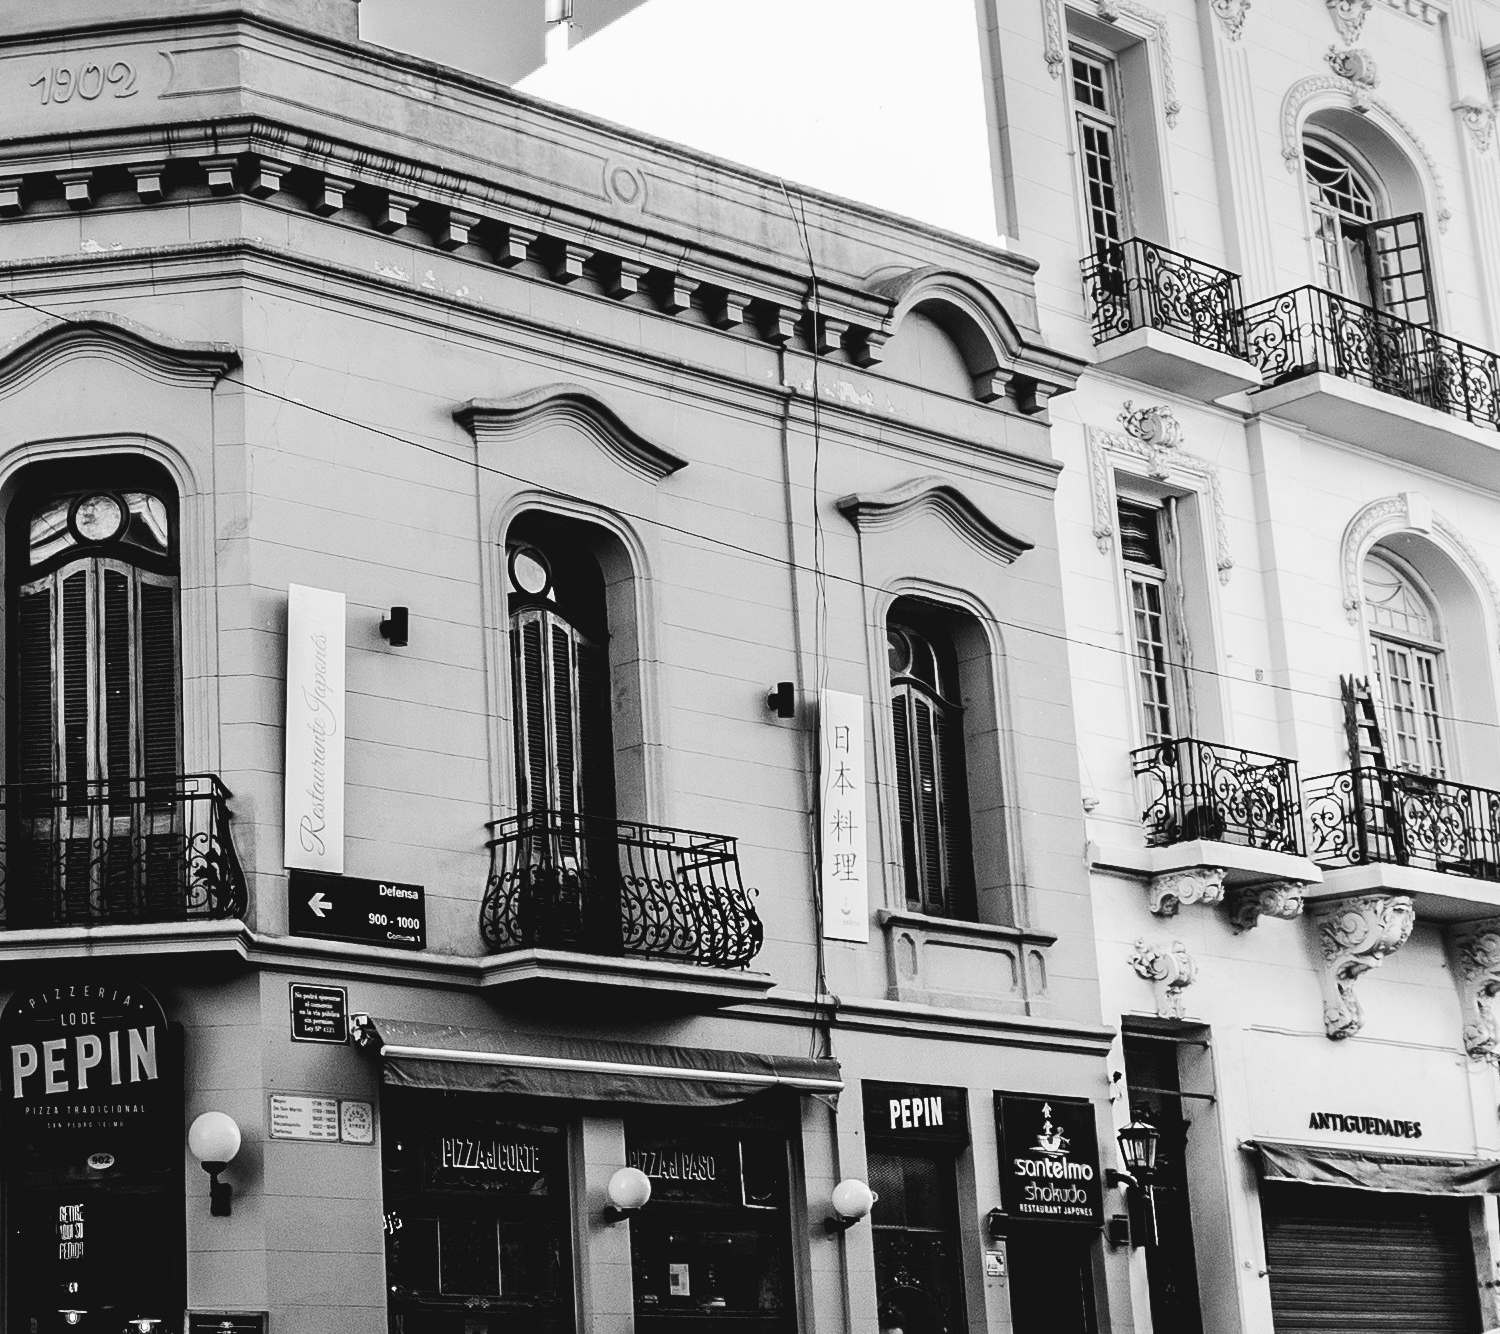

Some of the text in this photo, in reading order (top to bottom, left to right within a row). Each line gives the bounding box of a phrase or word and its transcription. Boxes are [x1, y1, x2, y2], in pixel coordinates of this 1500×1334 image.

[29, 62, 139, 105] 1902
[300, 629, 337, 856] Restaurante Japonés
[830, 725, 859, 882] 日本料理
[379, 885, 419, 900] Defensa
[368, 913, 387, 926] 900
[397, 916, 420, 929] 1000
[387, 931, 416, 942] Comuna
[29, 985, 131, 1009] PIZZERIA
[61, 1011, 97, 1026] LO DE
[11, 1026, 158, 1098] PEPIN
[25, 1105, 146, 1116] PIZZA TRADICIONAL
[890, 1097, 943, 1129] PEPIN
[1309, 1112, 1422, 1139] ANTIGUEDADES
[442, 1137, 486, 1169] PIZZA
[499, 1143, 540, 1174] CORTE
[682, 1152, 717, 1181] PASO
[1014, 1157, 1093, 1181] santelmo
[1025, 1181, 1087, 1204] shokudo
[1019, 1203, 1093, 1217] RESTAURANT JAPONES
